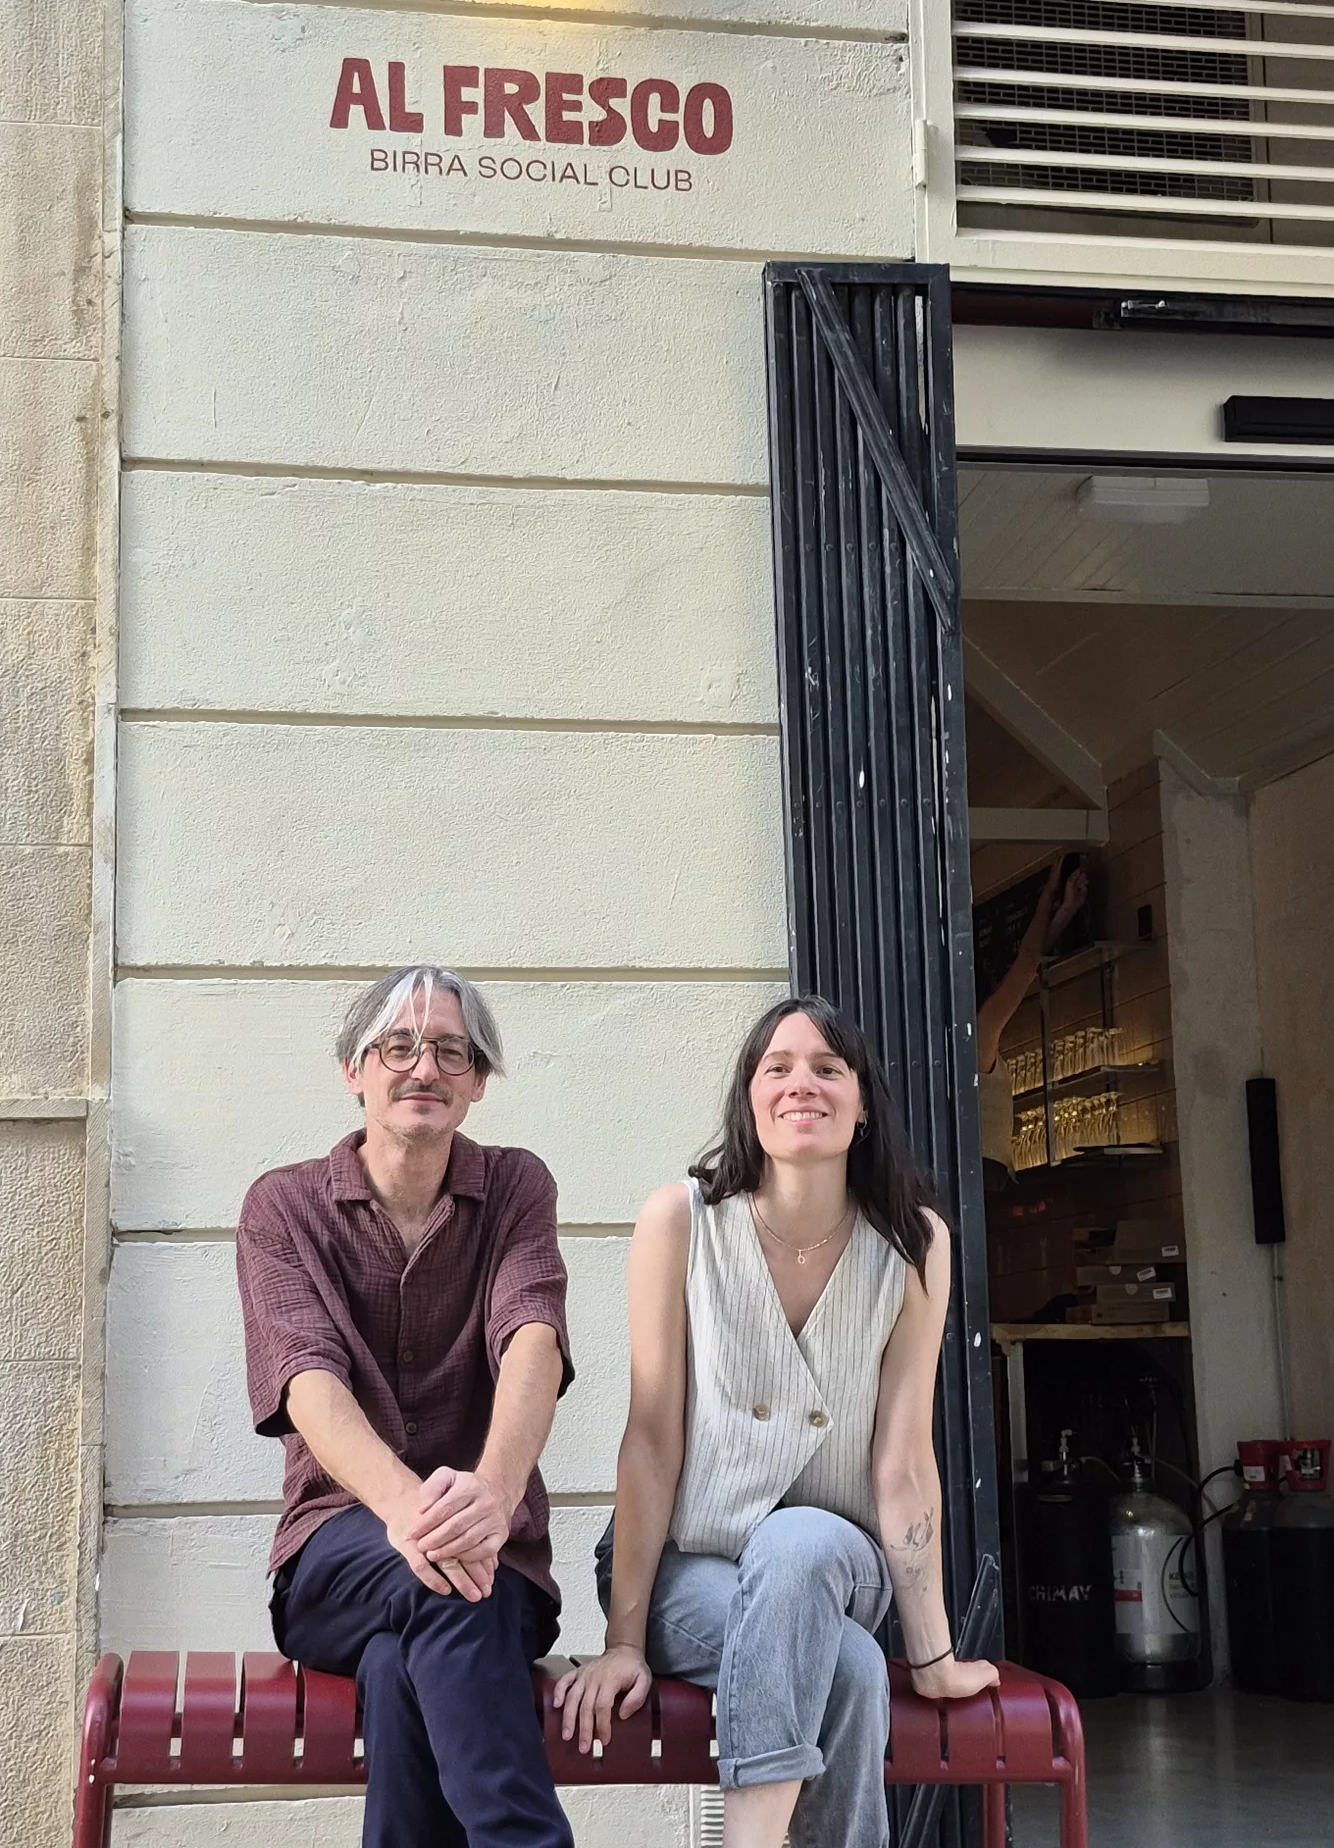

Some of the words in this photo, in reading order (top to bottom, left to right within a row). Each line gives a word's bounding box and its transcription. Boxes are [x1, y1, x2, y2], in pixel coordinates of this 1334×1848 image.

[330, 57, 423, 133] AL
[443, 64, 733, 155] FRESCO
[370, 149, 467, 177] BIRRA
[479, 157, 599, 186] SOCIAL
[608, 166, 693, 192] CLUB
[1028, 1584, 1092, 1602] CHIMAY
